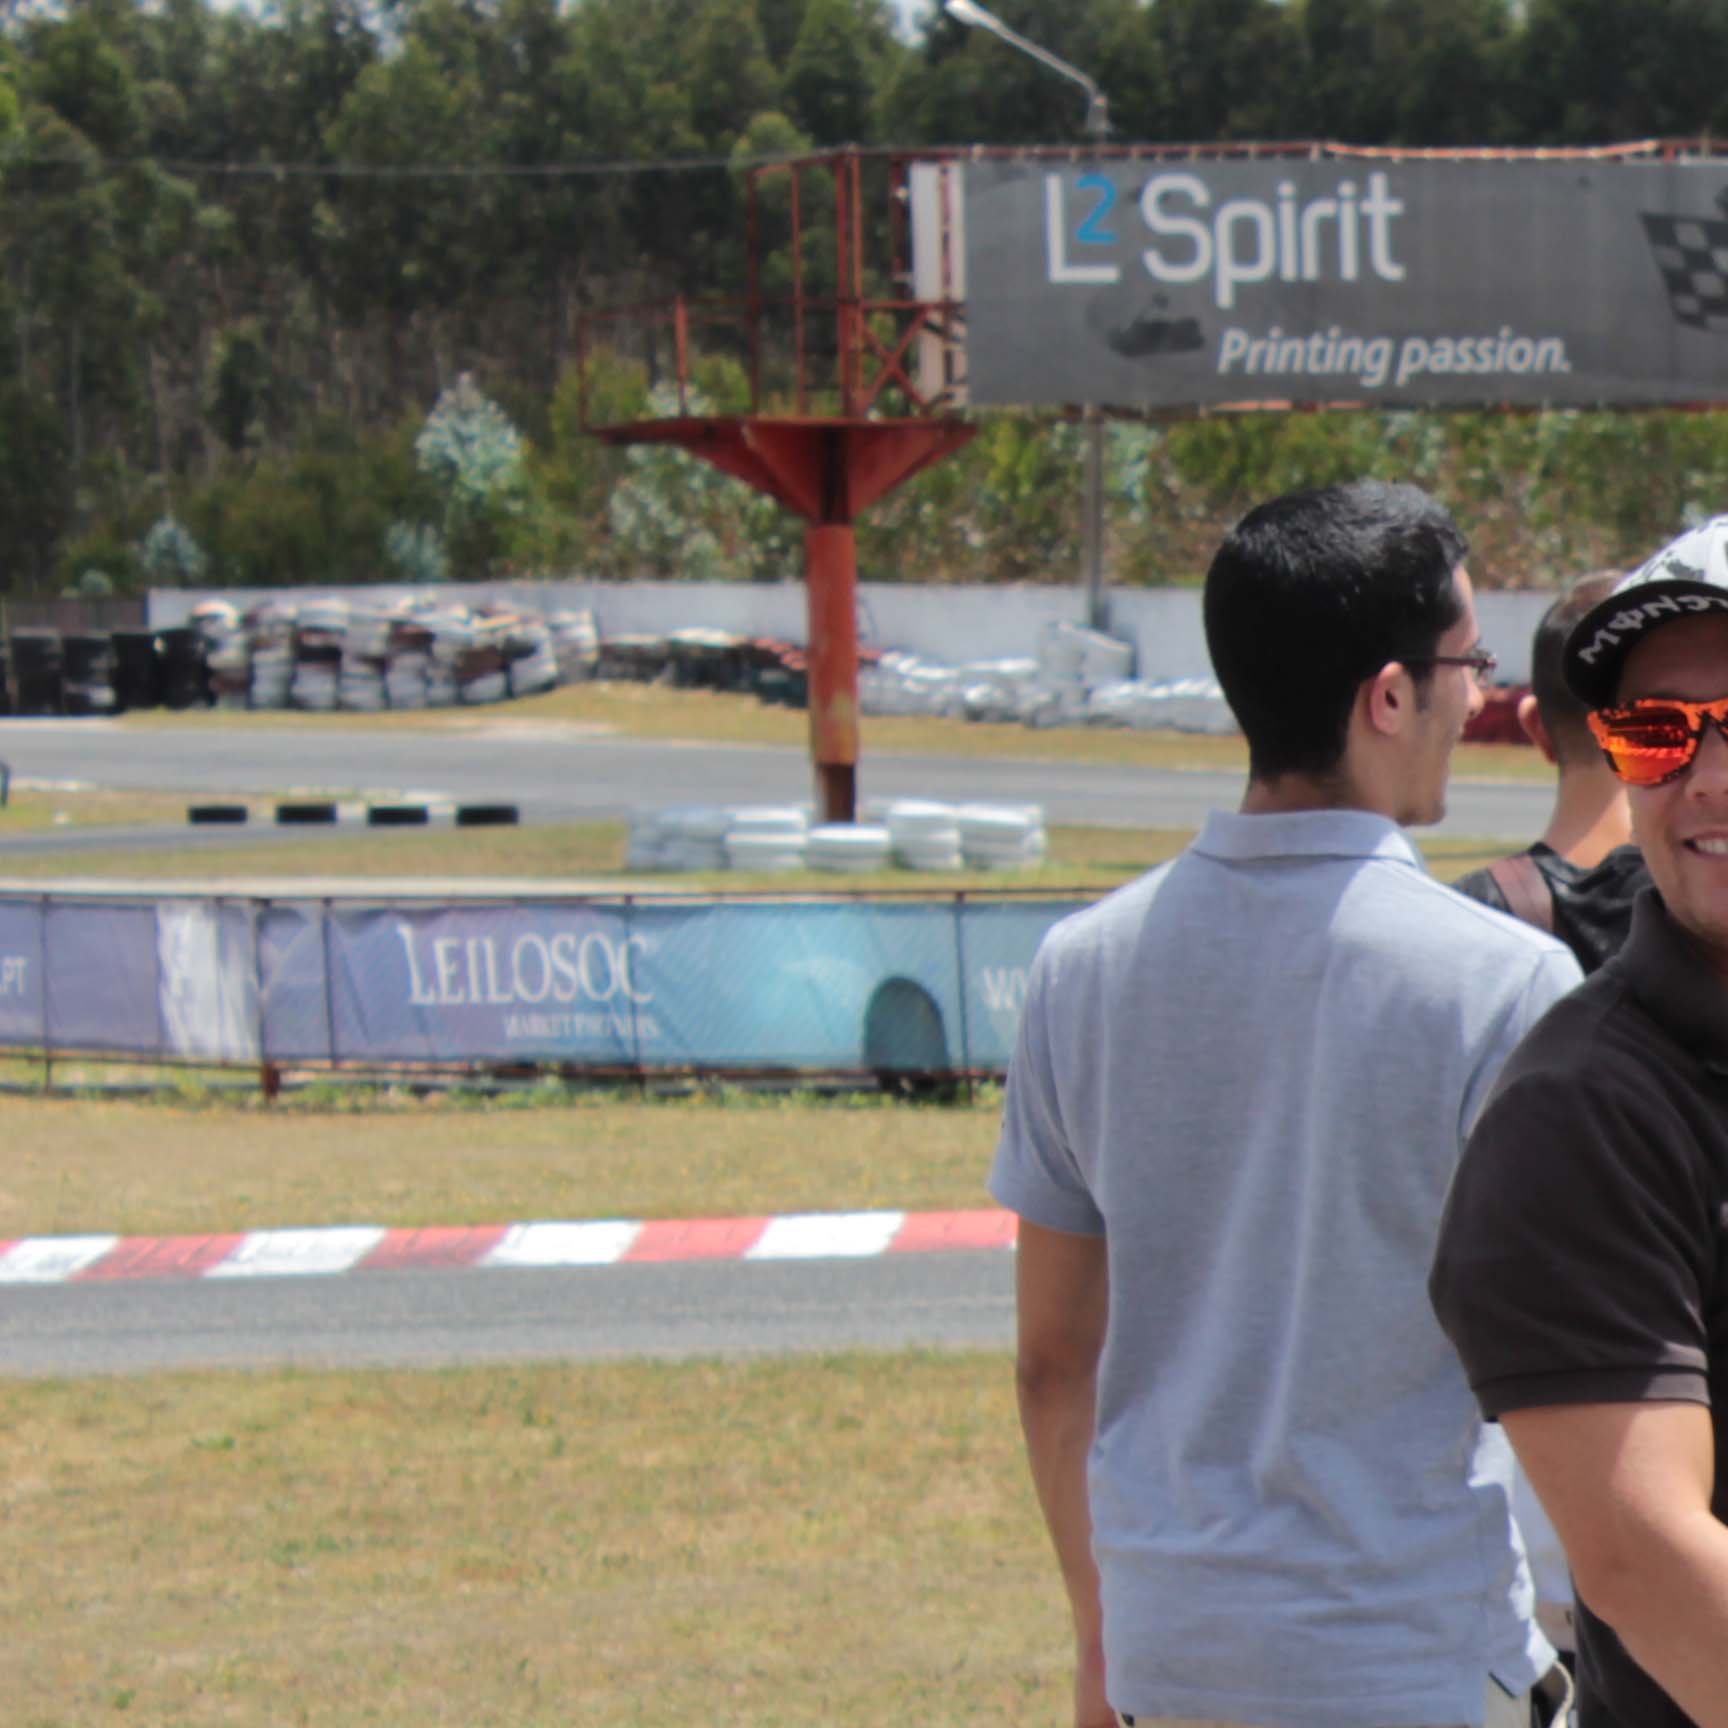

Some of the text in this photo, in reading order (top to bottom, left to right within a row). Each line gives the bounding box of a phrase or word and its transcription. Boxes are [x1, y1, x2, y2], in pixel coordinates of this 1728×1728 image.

[1142, 172, 1406, 309] Spirit
[1218, 326, 1573, 388] Printing passion.
[396, 922, 657, 1005] LEILOSOC
